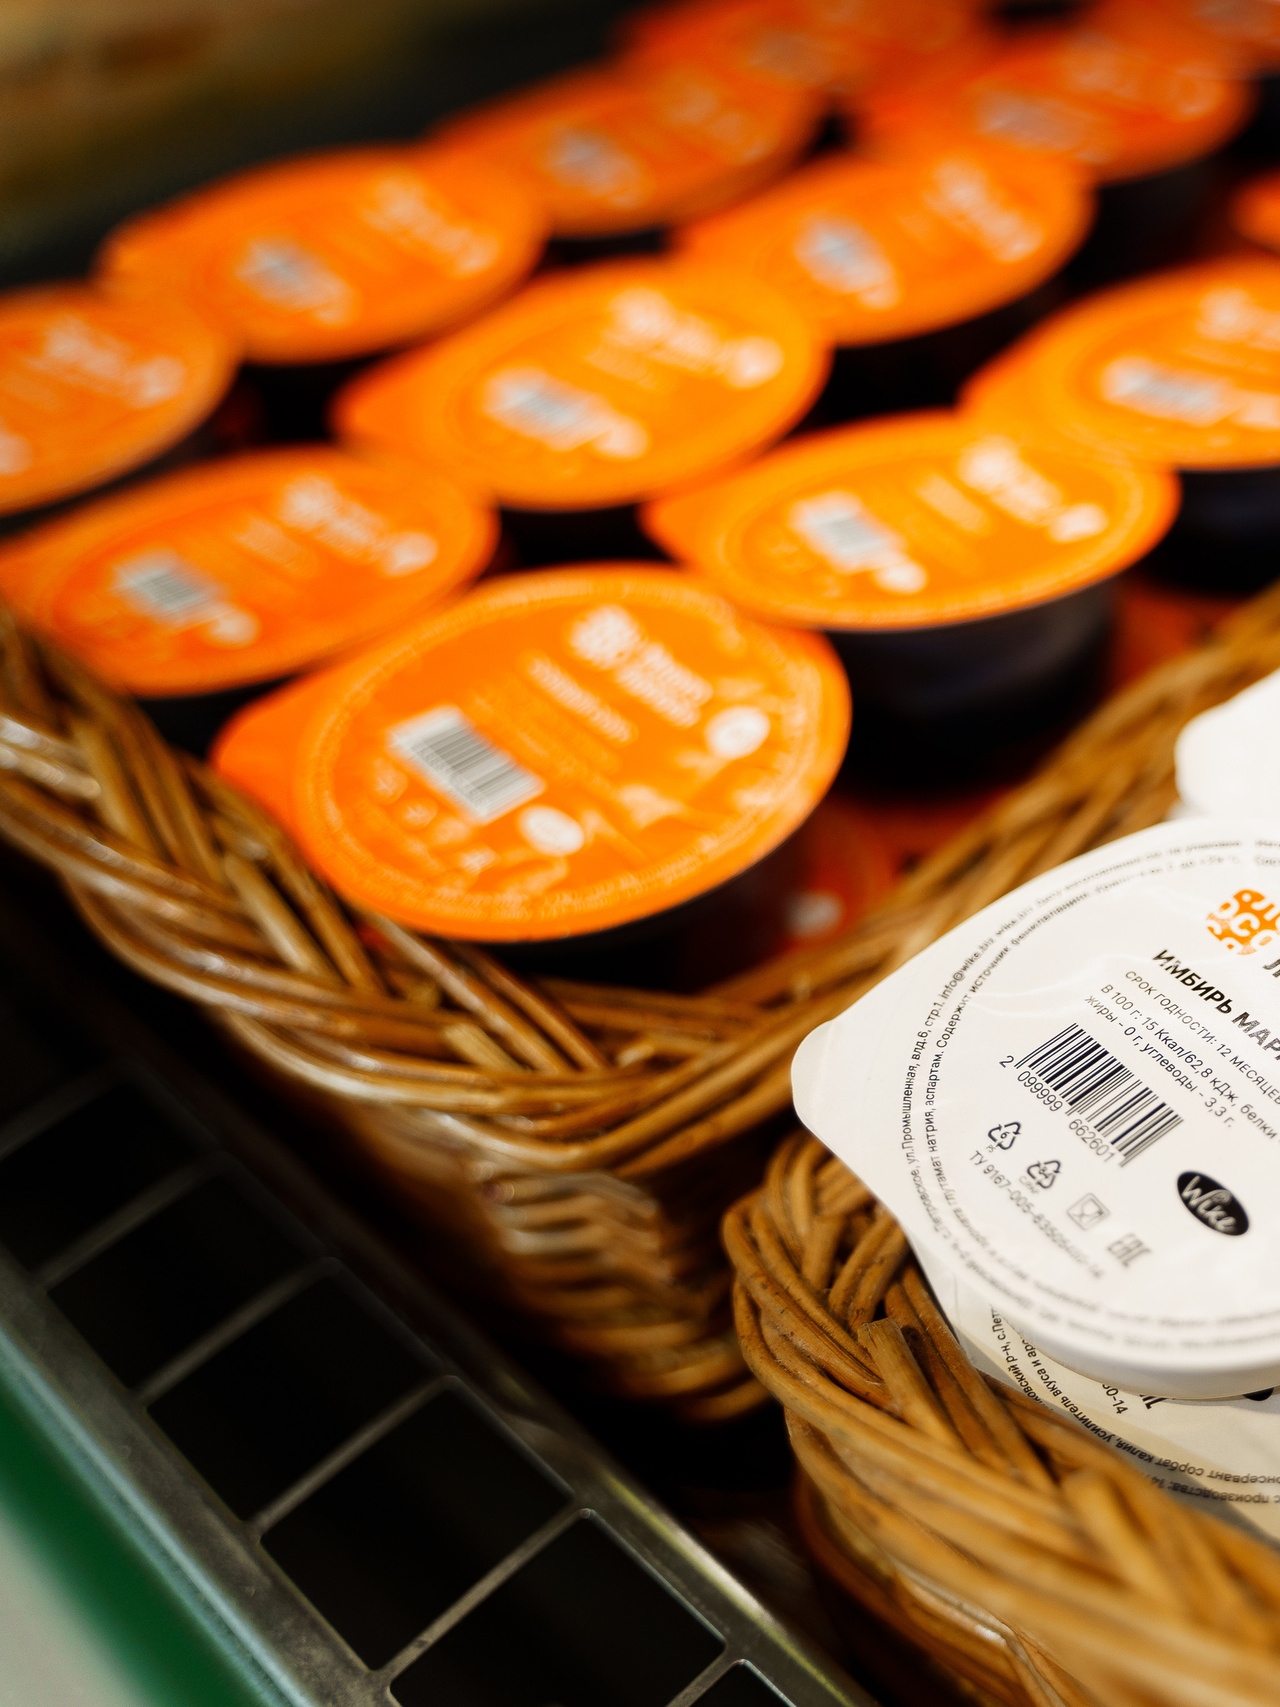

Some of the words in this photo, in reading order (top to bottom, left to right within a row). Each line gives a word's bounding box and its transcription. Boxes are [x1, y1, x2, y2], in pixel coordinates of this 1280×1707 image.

[969, 945, 1011, 995] источник
[1152, 949, 1233, 1014] ИМБИРЬ
[936, 994, 972, 1048] Содержит
[1125, 970, 1157, 996] СРОК
[1153, 992, 1218, 1046] ГОДНОСТИ:
[1217, 1043, 1232, 1058] 12
[925, 1050, 945, 1106] аспартам.
[1084, 995, 1118, 1023] жиры
[1124, 1026, 1137, 1037] 0
[1132, 1034, 1144, 1047] г,
[1139, 1042, 1199, 1092] углеводы
[1204, 1096, 1227, 1117] 3,3
[1222, 1116, 1235, 1129] г.
[1100, 984, 1113, 994] В
[1110, 991, 1134, 1011] 100
[1131, 1008, 1143, 1020] г:
[1141, 1016, 1159, 1032] 15
[1154, 1027, 1214, 1079] Ккал/62,8
[1209, 1076, 1239, 1108] кДж,
[1240, 1103, 1278, 1140] белки
[901, 1062, 921, 1165] ул.Промышленная,
[911, 1028, 932, 1061] влд.6,
[999, 1055, 1015, 1068] 2
[1017, 1069, 1064, 1112] 099999
[1068, 1118, 1116, 1164] 662601
[924, 1108, 939, 1153] натрия,
[969, 1150, 987, 1166] ТУ
[991, 1308, 1007, 1341] с.Пет
[1000, 1341, 1018, 1364] р-н,
[1031, 1359, 1042, 1368] и
[1007, 1365, 1042, 1402] ковский
[1036, 1367, 1062, 1397] вкуса
[1060, 1394, 1116, 1443] усилитель
[1115, 1437, 1155, 1464] калия,
[1155, 1457, 1205, 1477] сорбат
